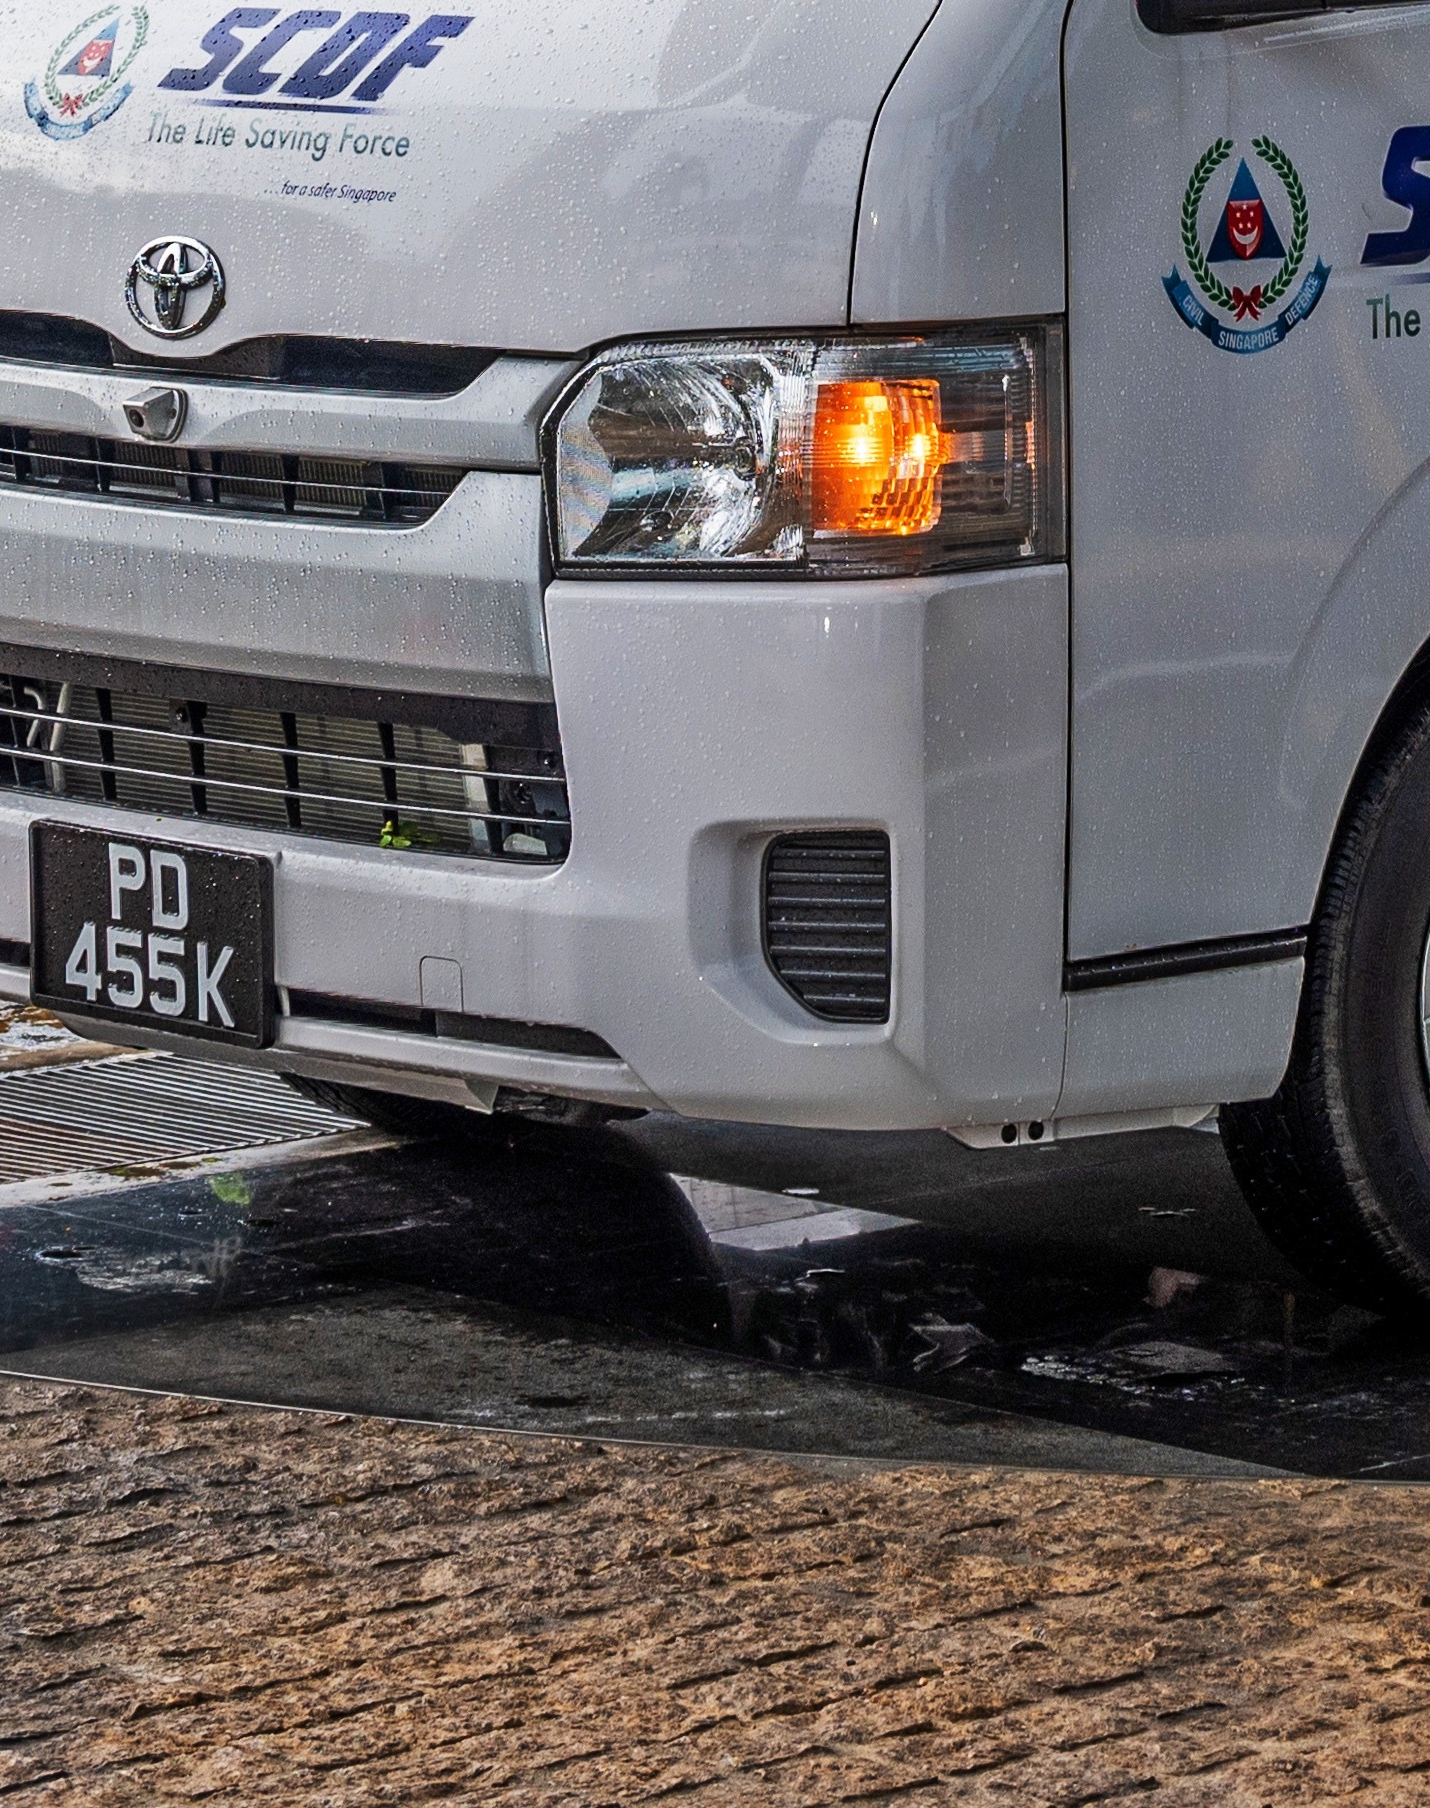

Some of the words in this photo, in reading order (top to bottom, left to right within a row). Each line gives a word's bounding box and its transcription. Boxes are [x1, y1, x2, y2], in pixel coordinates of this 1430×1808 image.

[156, 6, 476, 103] SCDF
[146, 111, 186, 146] The
[195, 112, 236, 149] Life
[245, 118, 331, 162] Saving
[339, 124, 411, 159] Force
[308, 182, 337, 200] safer
[337, 183, 397, 205] Singapore
[1182, 294, 1204, 327] CIVIL
[1218, 326, 1280, 351] SINGAPORE
[1285, 274, 1319, 326] DEFENCE
[1367, 297, 1422, 341] The
[107, 841, 189, 931] PD
[65, 920, 236, 1029] 455K
